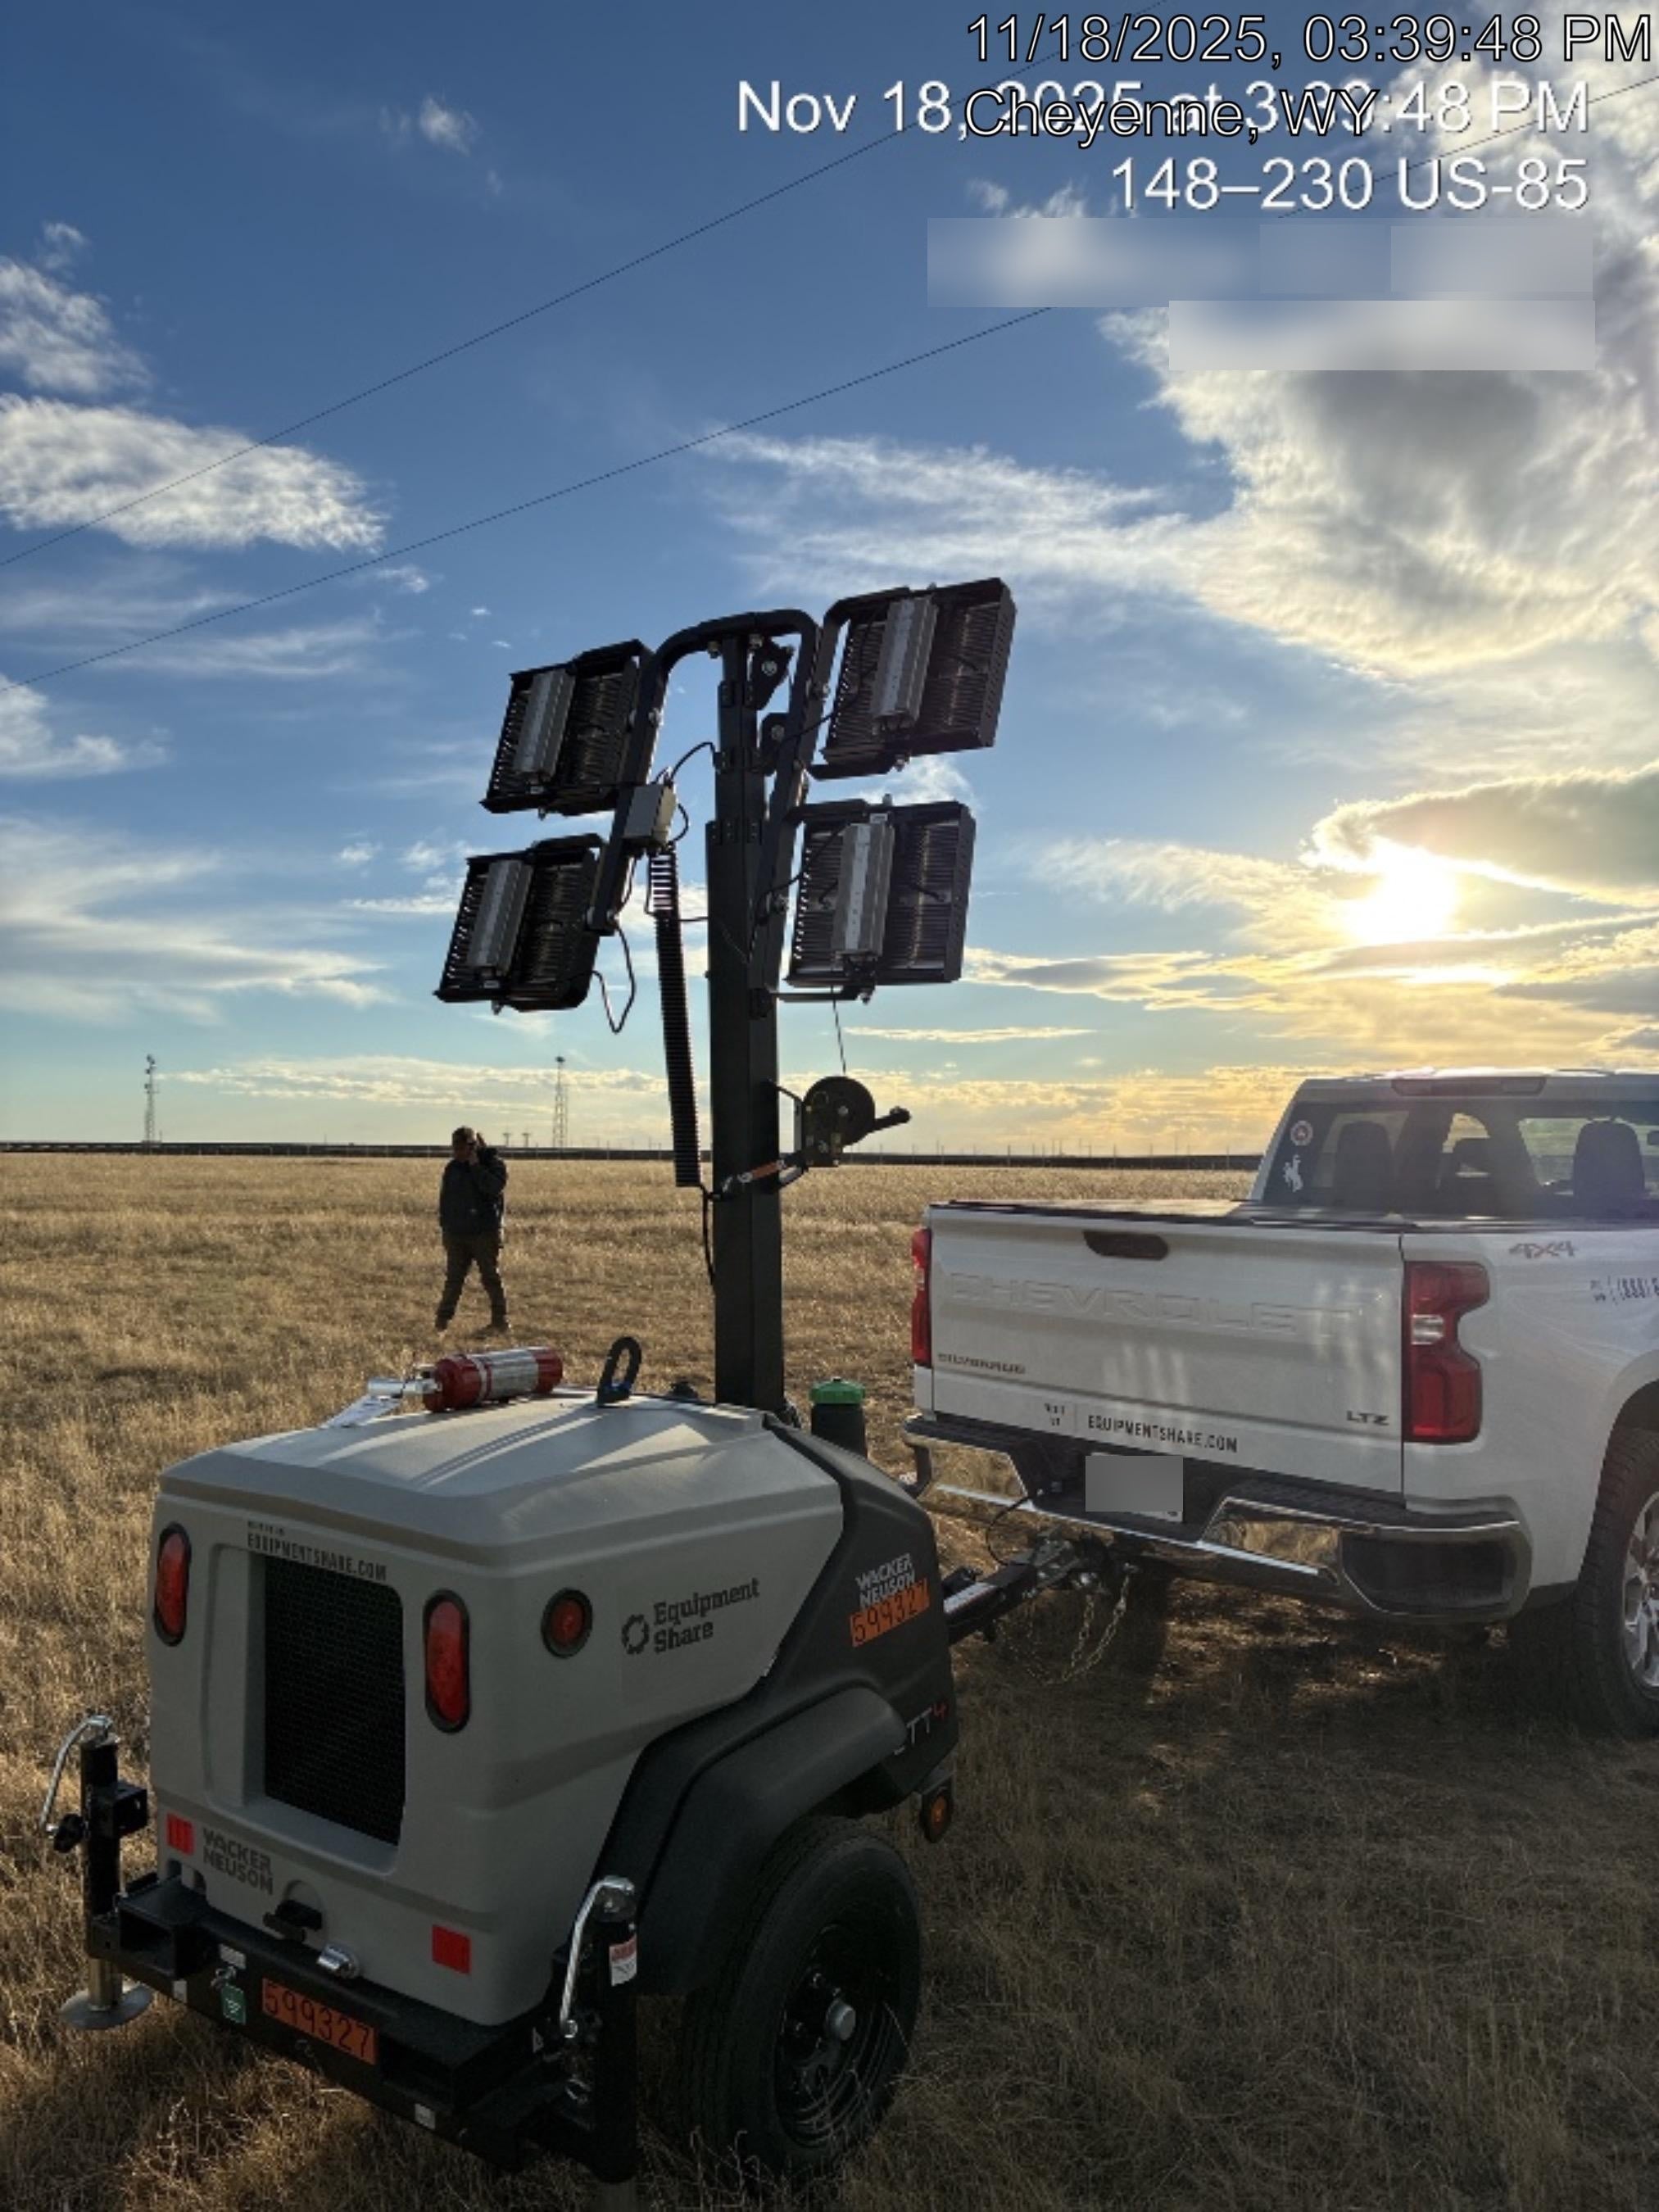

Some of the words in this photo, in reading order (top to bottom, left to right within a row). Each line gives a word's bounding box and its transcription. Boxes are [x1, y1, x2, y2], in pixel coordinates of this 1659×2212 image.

[1346, 1410, 1390, 1426] LTZ
[654, 1578, 759, 1625] Equipment
[654, 1622, 714, 1653] Share
[203, 1828, 272, 1876] WACKER
[203, 1846, 274, 1896] NEUSON
[265, 1981, 369, 2058] 599327
